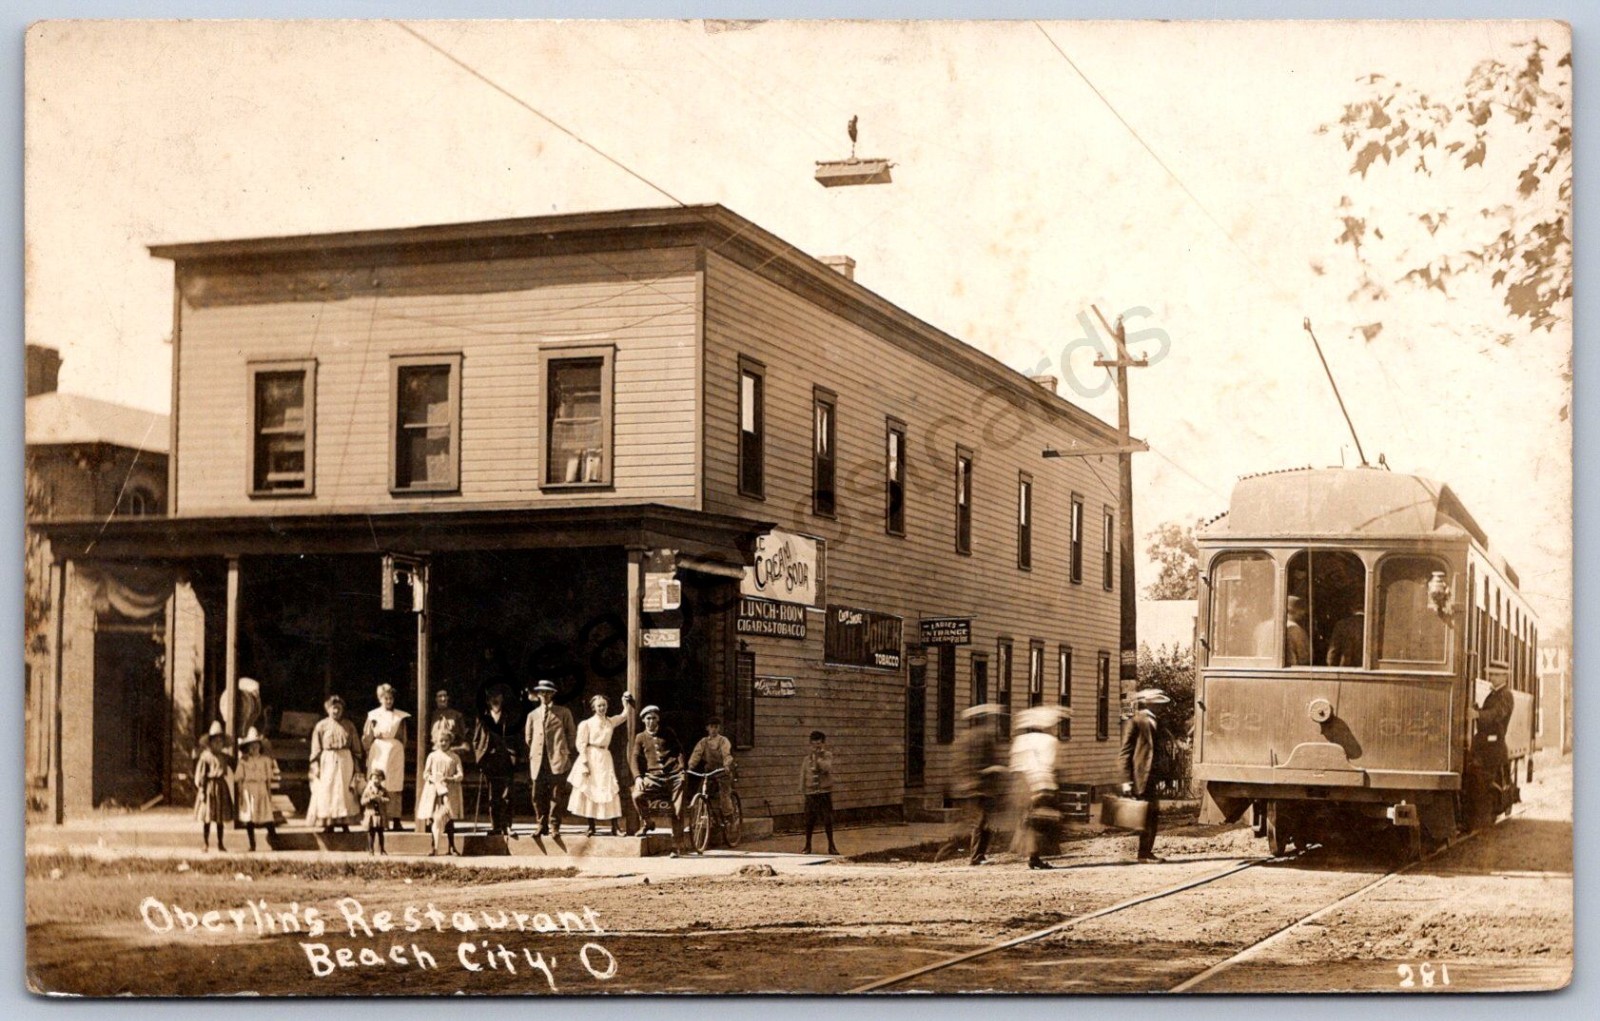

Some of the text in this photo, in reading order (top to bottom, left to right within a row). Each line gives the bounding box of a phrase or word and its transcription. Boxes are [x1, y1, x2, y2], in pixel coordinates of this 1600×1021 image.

[754, 541, 791, 592] CREAM
[786, 562, 809, 594] SODA
[863, 614, 900, 654] POUCH
[921, 629, 968, 637] ENTRANCE
[931, 621, 957, 630] LADIES
[875, 653, 900, 667] TOBACCO
